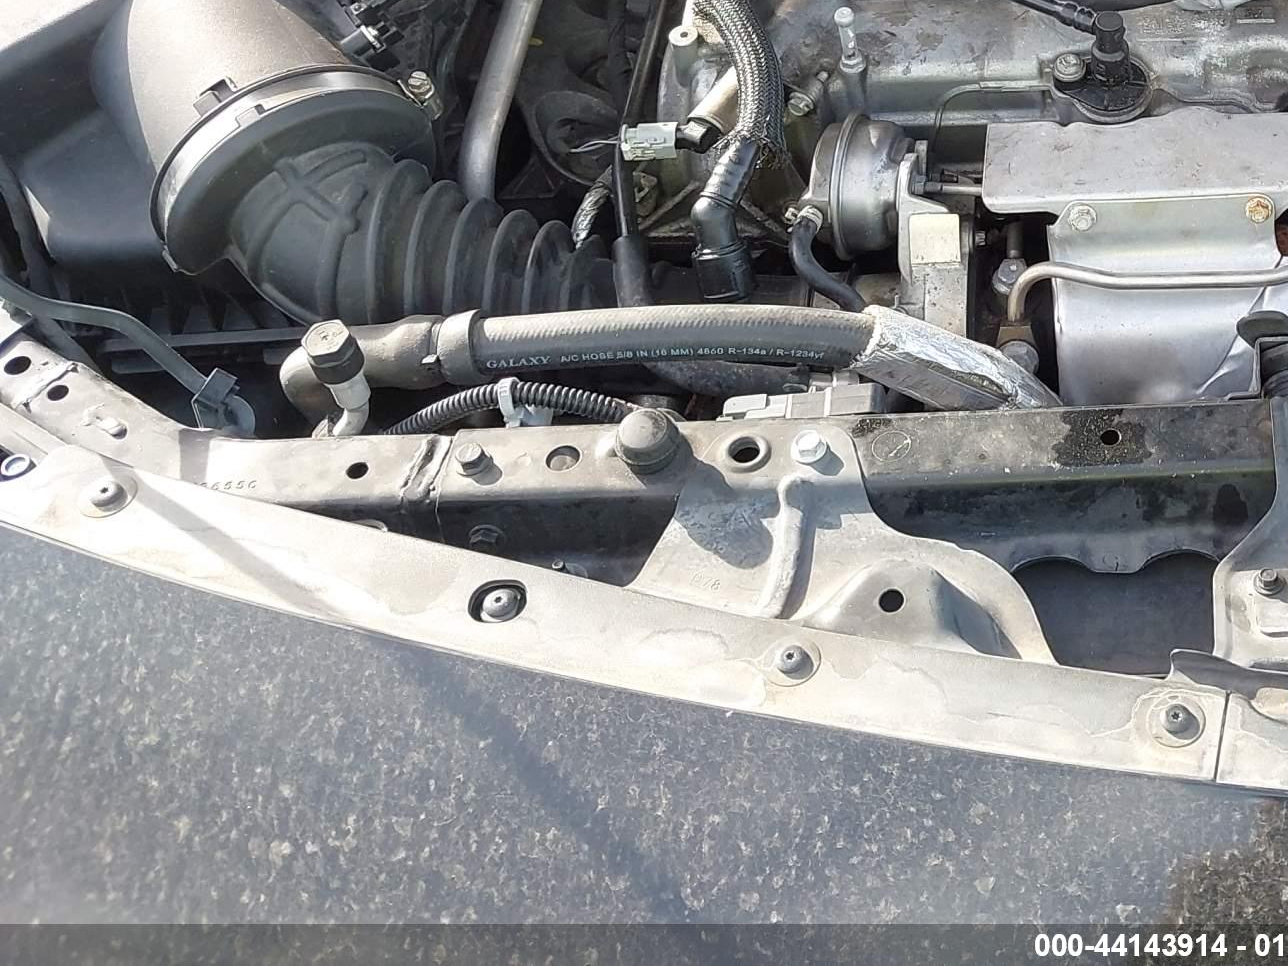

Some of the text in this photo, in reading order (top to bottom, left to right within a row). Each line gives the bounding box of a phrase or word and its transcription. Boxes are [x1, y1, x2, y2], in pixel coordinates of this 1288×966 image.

[486, 355, 551, 369] GALAXY
[560, 355, 579, 363] A/C
[582, 352, 614, 361] HOSE
[616, 351, 633, 360] 5/8
[636, 350, 648, 358] IN
[670, 349, 694, 357] MM)
